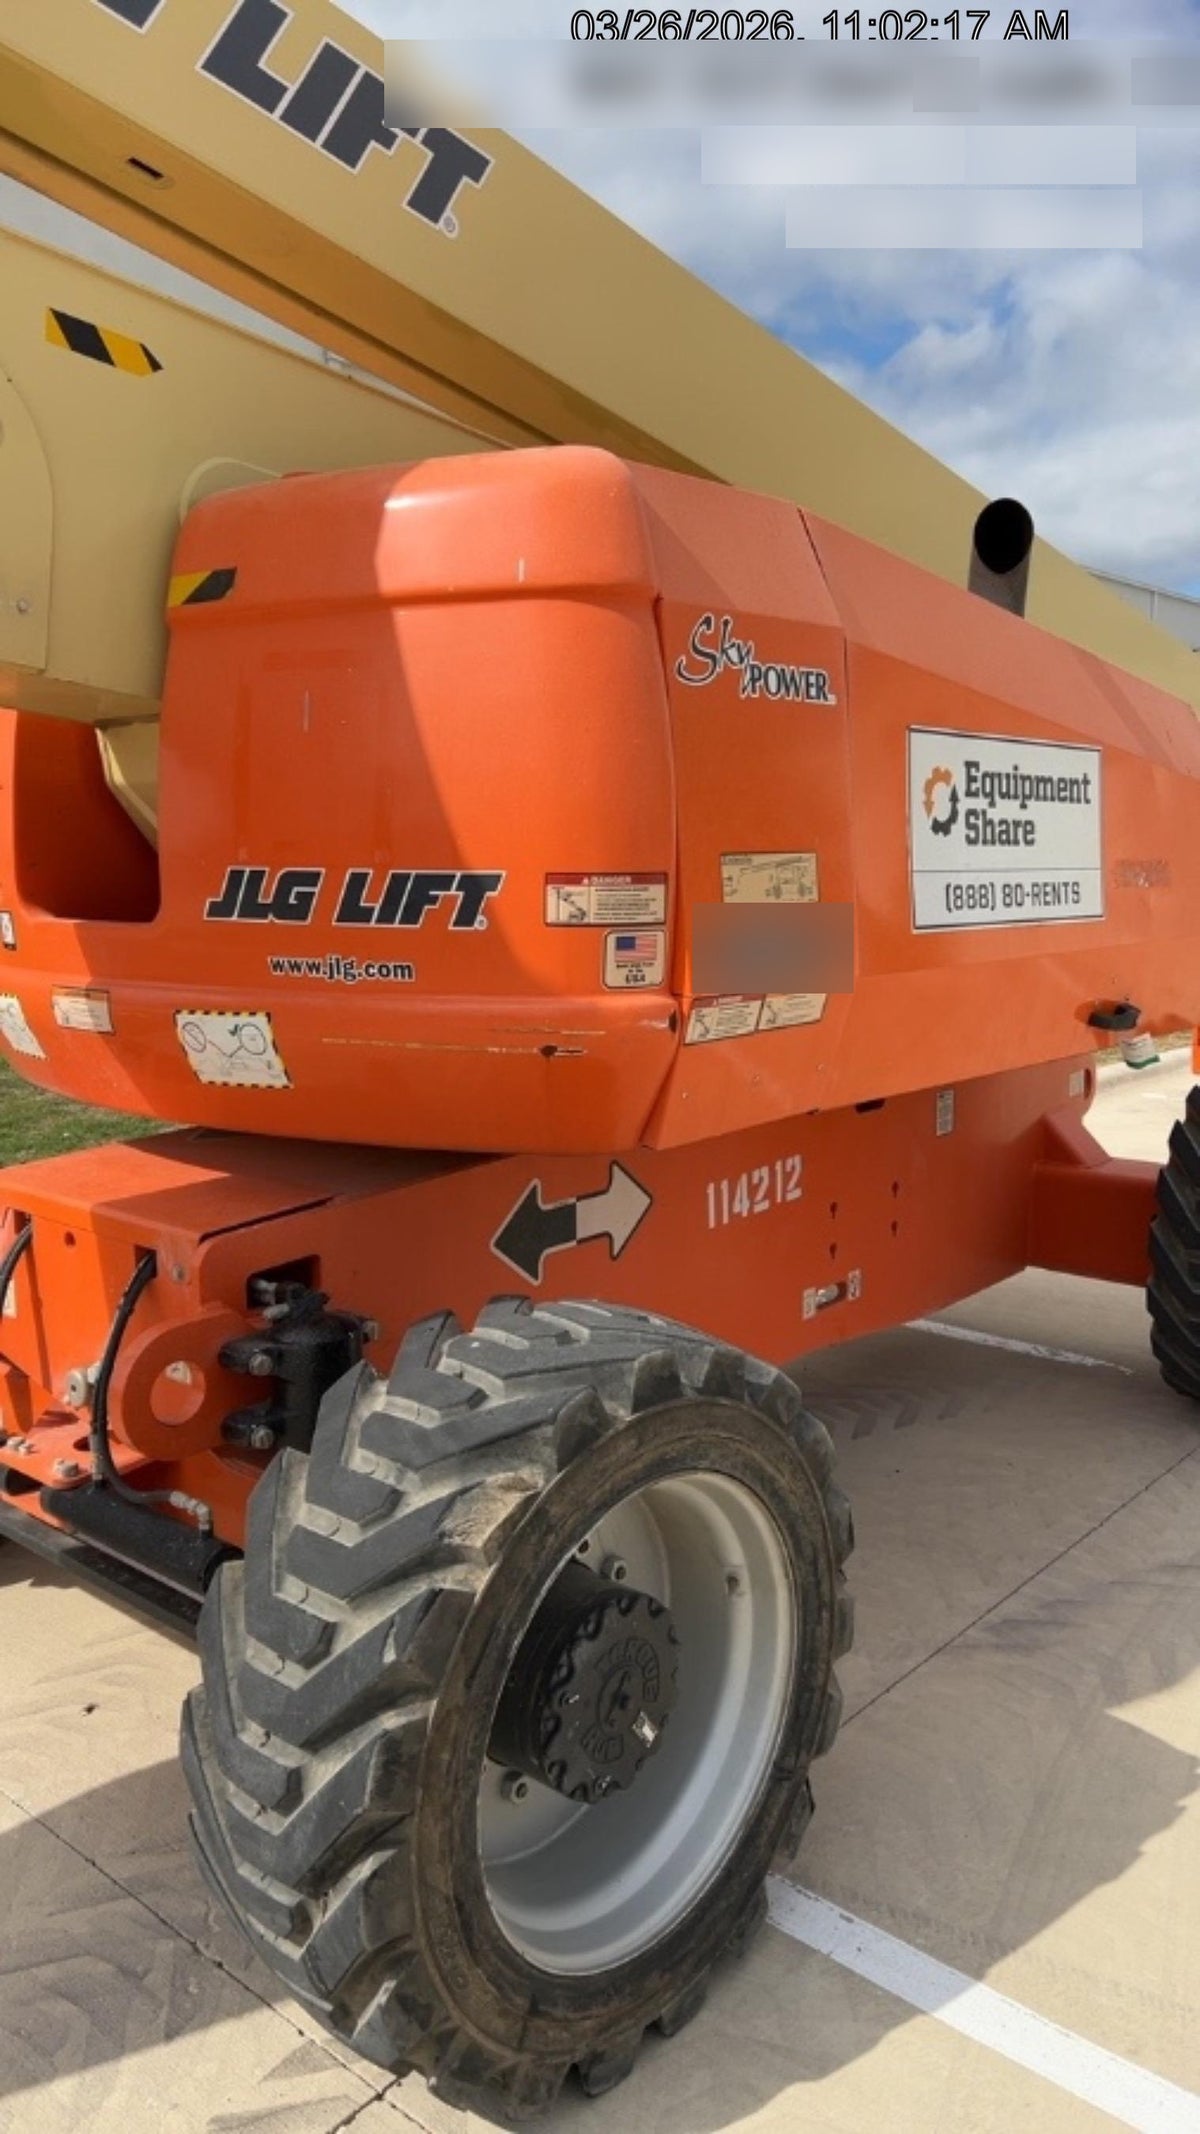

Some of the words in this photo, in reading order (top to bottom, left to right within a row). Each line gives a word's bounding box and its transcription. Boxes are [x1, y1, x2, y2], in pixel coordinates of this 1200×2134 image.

[964, 760, 1092, 809] Equipment
[964, 808, 1036, 847] Share
[205, 867, 323, 924] JLG
[334, 870, 505, 930] LIFT
[945, 883, 996, 913] (888)
[1002, 881, 1081, 908] 80-RENTS
[269, 955, 416, 983] www.jlg.com
[706, 1154, 803, 1230] 114212
